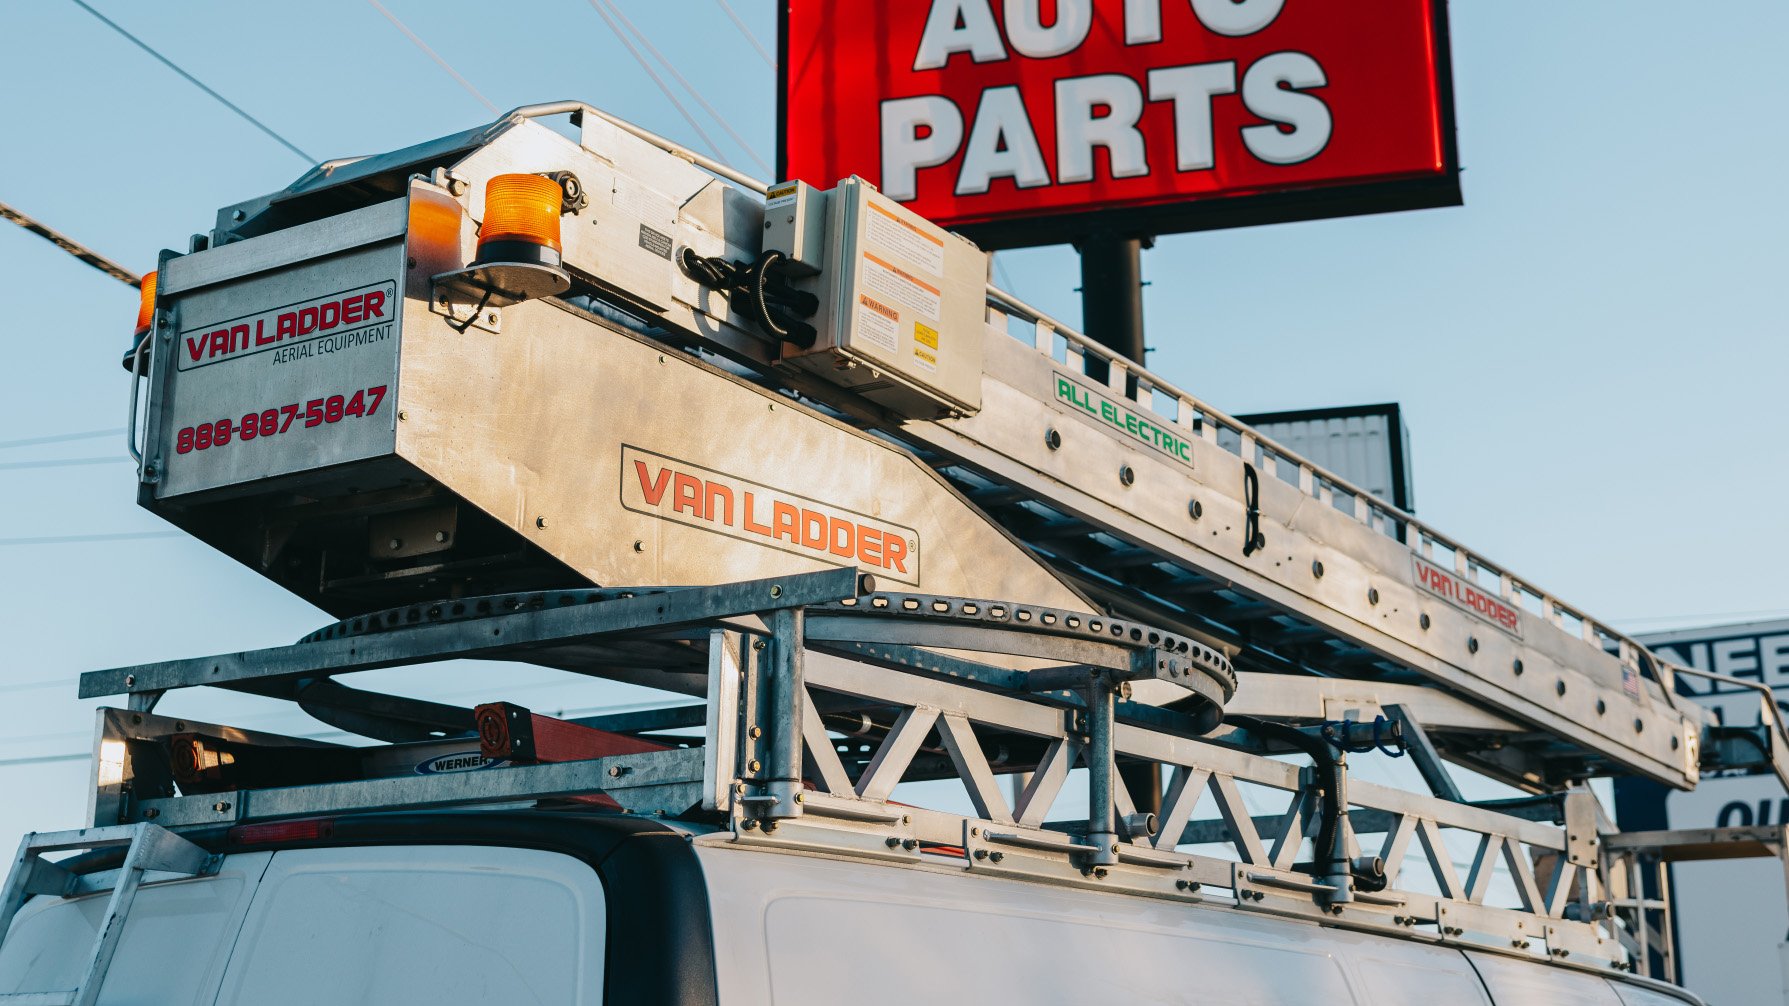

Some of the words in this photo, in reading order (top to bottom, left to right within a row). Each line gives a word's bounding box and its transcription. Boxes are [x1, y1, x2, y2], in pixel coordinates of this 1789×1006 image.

[881, 52, 1332, 201] PARTS
[776, 187, 795, 197] CAUTION
[868, 299, 898, 320] WARNING
[187, 324, 249, 362] VAN
[273, 341, 313, 365] AERIAL
[318, 324, 393, 354] EQUIPMENT
[177, 385, 387, 454] 888-887-5847
[1058, 379, 1097, 414] ALL
[1101, 401, 1190, 462] ELECTRIC
[634, 460, 734, 527] VAN
[1416, 561, 1452, 598] VAN
[1456, 582, 1518, 633] LADDER
[435, 757, 488, 771] WERNER
